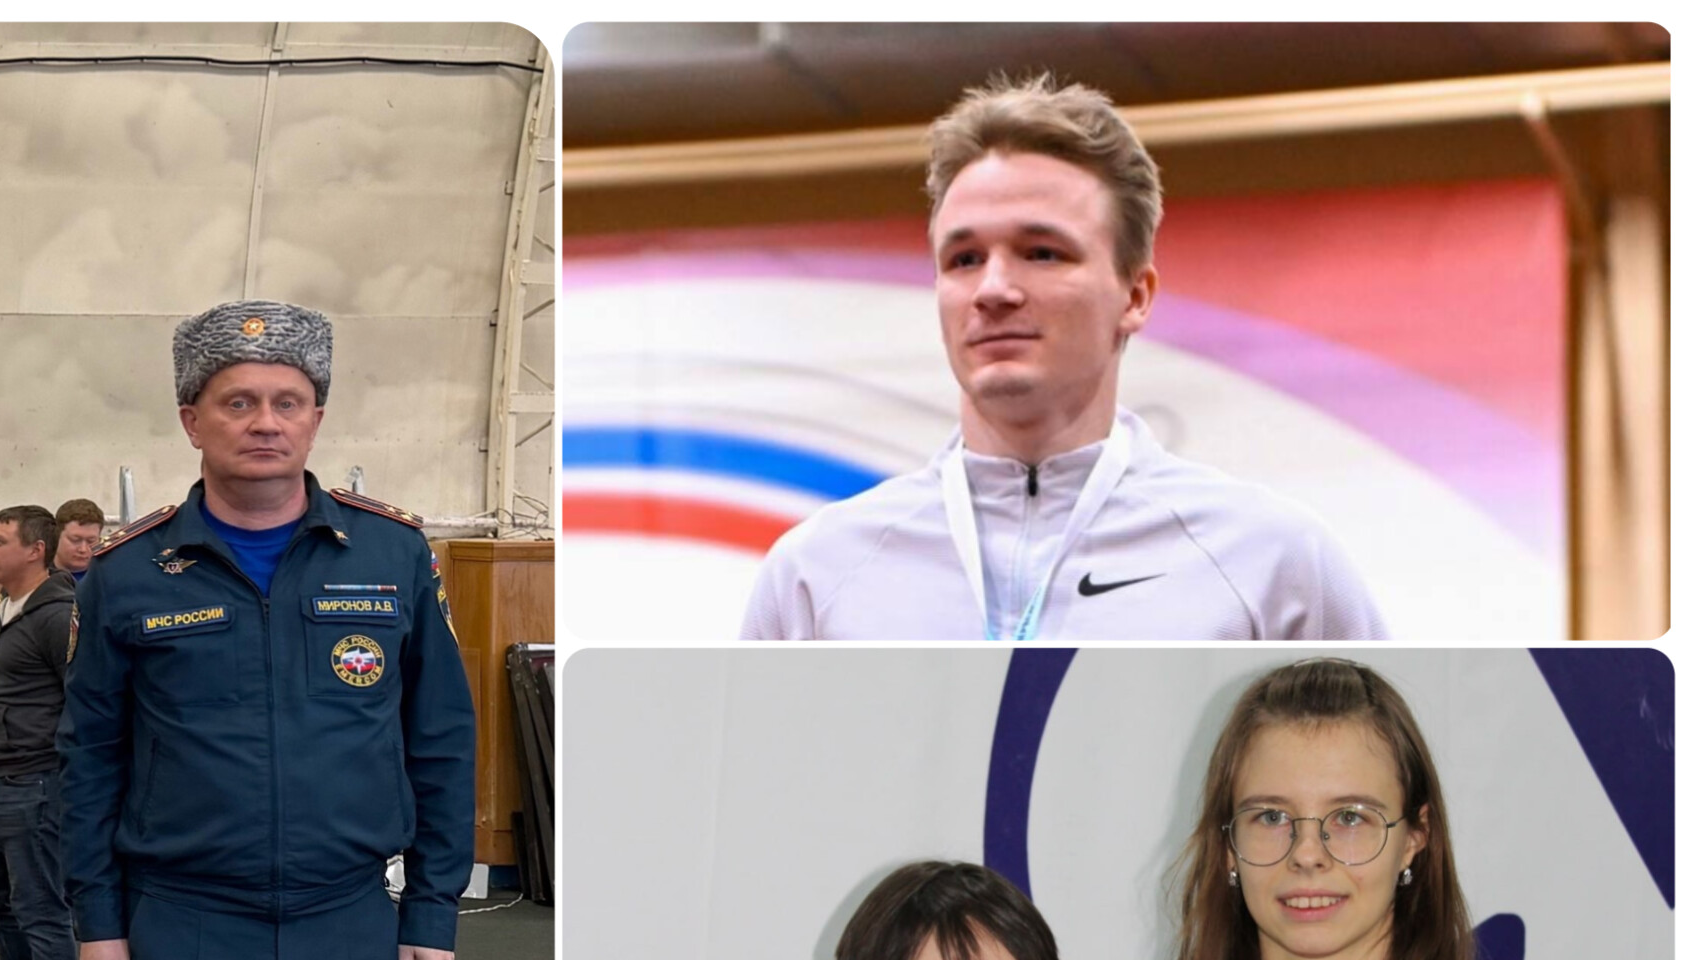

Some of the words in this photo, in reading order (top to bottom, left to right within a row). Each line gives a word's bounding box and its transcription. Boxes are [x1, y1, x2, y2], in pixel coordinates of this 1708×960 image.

[317, 600, 372, 612] МИРОНОВ
[146, 616, 172, 629] МЧС
[174, 607, 224, 627] РОССИИ
